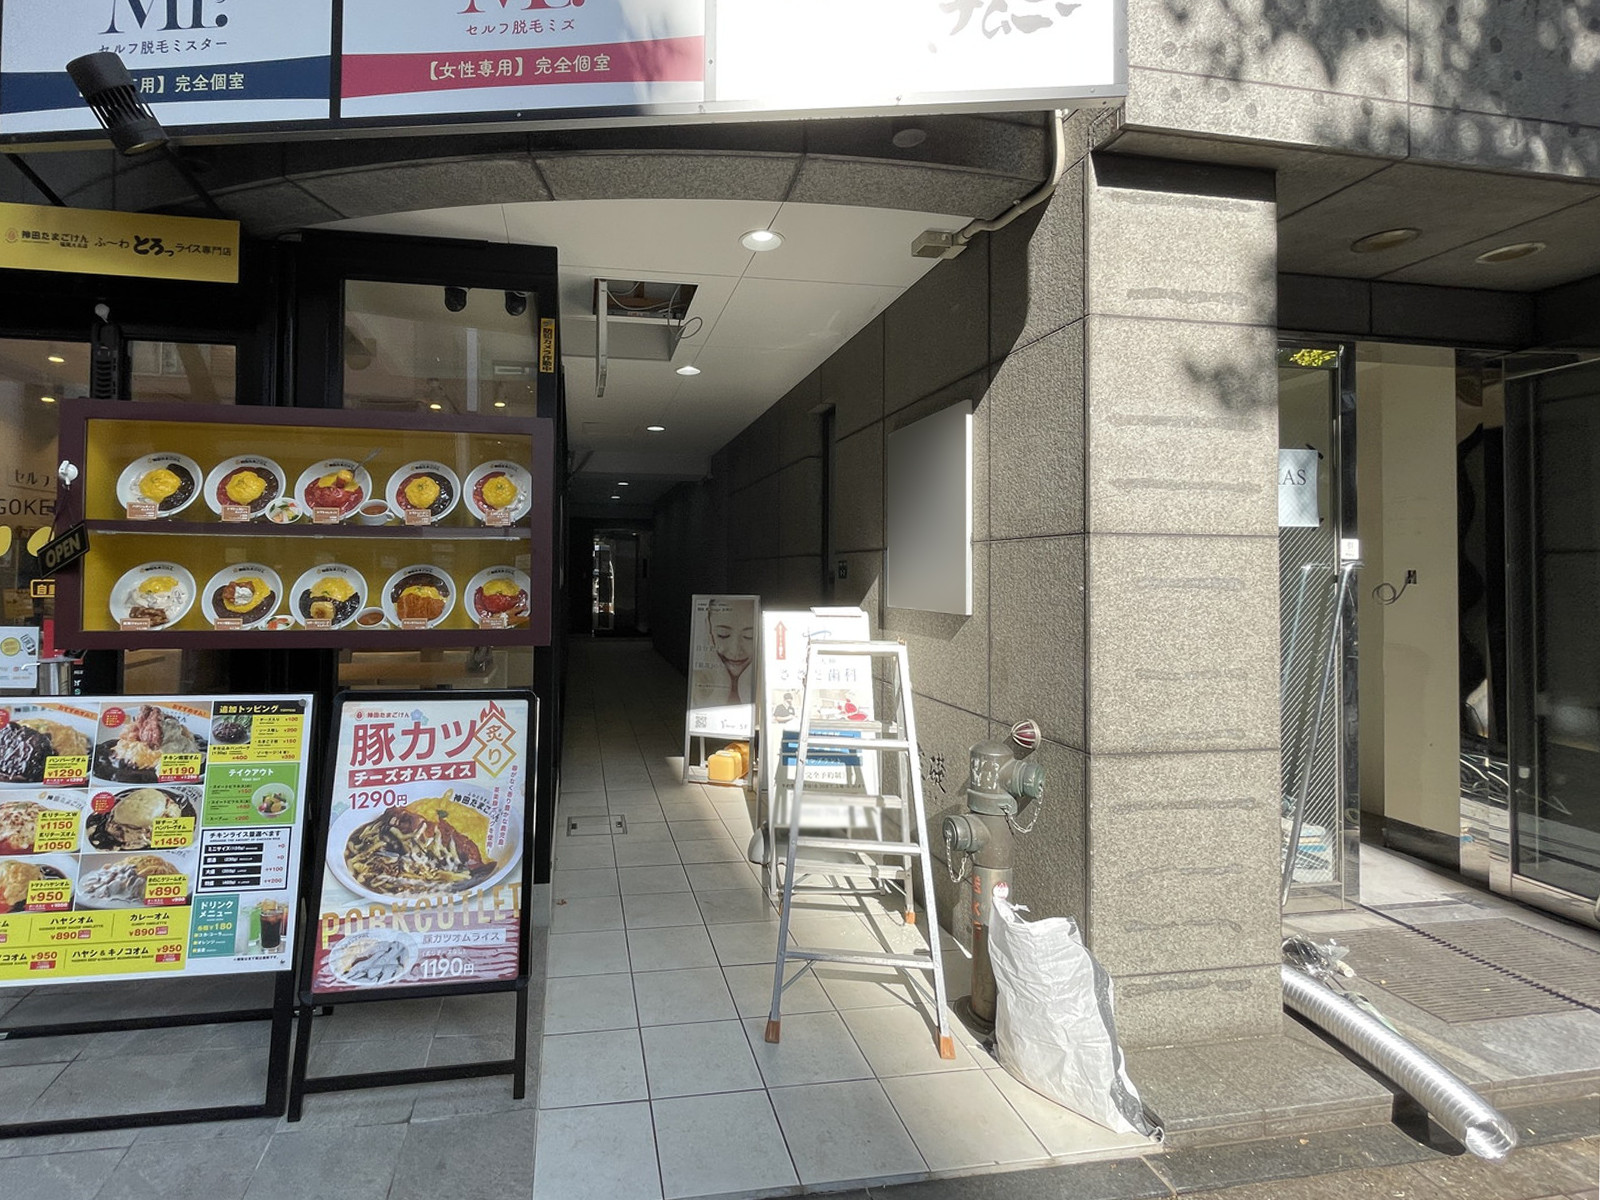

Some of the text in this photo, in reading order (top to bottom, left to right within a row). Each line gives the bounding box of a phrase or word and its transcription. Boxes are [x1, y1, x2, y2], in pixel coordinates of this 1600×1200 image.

[465, 18, 575, 36] セルフ脱毛ミズ
[98, 38, 229, 55] セルフ脱毛ミスター
[428, 53, 611, 82] 【女性専用】 完全個室
[175, 73, 246, 94] 完全個室
[1278, 468, 1308, 486] AS
[44, 532, 82, 569] OPEN
[219, 704, 280, 714] 追加トッピング
[350, 719, 477, 767] 豚カツ
[485, 724, 504, 766] 炙り
[47, 768, 83, 779] ¥1290
[162, 766, 196, 776] ¥1190
[228, 768, 274, 777] テイクアウト
[353, 764, 473, 786] チーズオムライス
[348, 789, 408, 810] 1290円
[41, 820, 73, 831] ¥1150
[38, 840, 72, 851] ¥1050
[154, 836, 187, 847] ¥1450
[30, 890, 64, 903] ¥950
[149, 885, 182, 898] ¥890
[200, 900, 235, 911] ドリンク
[50, 916, 94, 926] ハヤシオム
[130, 912, 170, 923] カレーオム
[199, 910, 234, 919] メニュー
[51, 931, 78, 941] ¥890
[129, 928, 155, 938] ¥890
[0, 953, 28, 963] コオム
[31, 950, 58, 961] ¥950
[72, 949, 98, 958] ハヤシ
[108, 947, 149, 957] キノコオム
[156, 943, 183, 954] ¥950
[420, 957, 475, 979] 1190円
